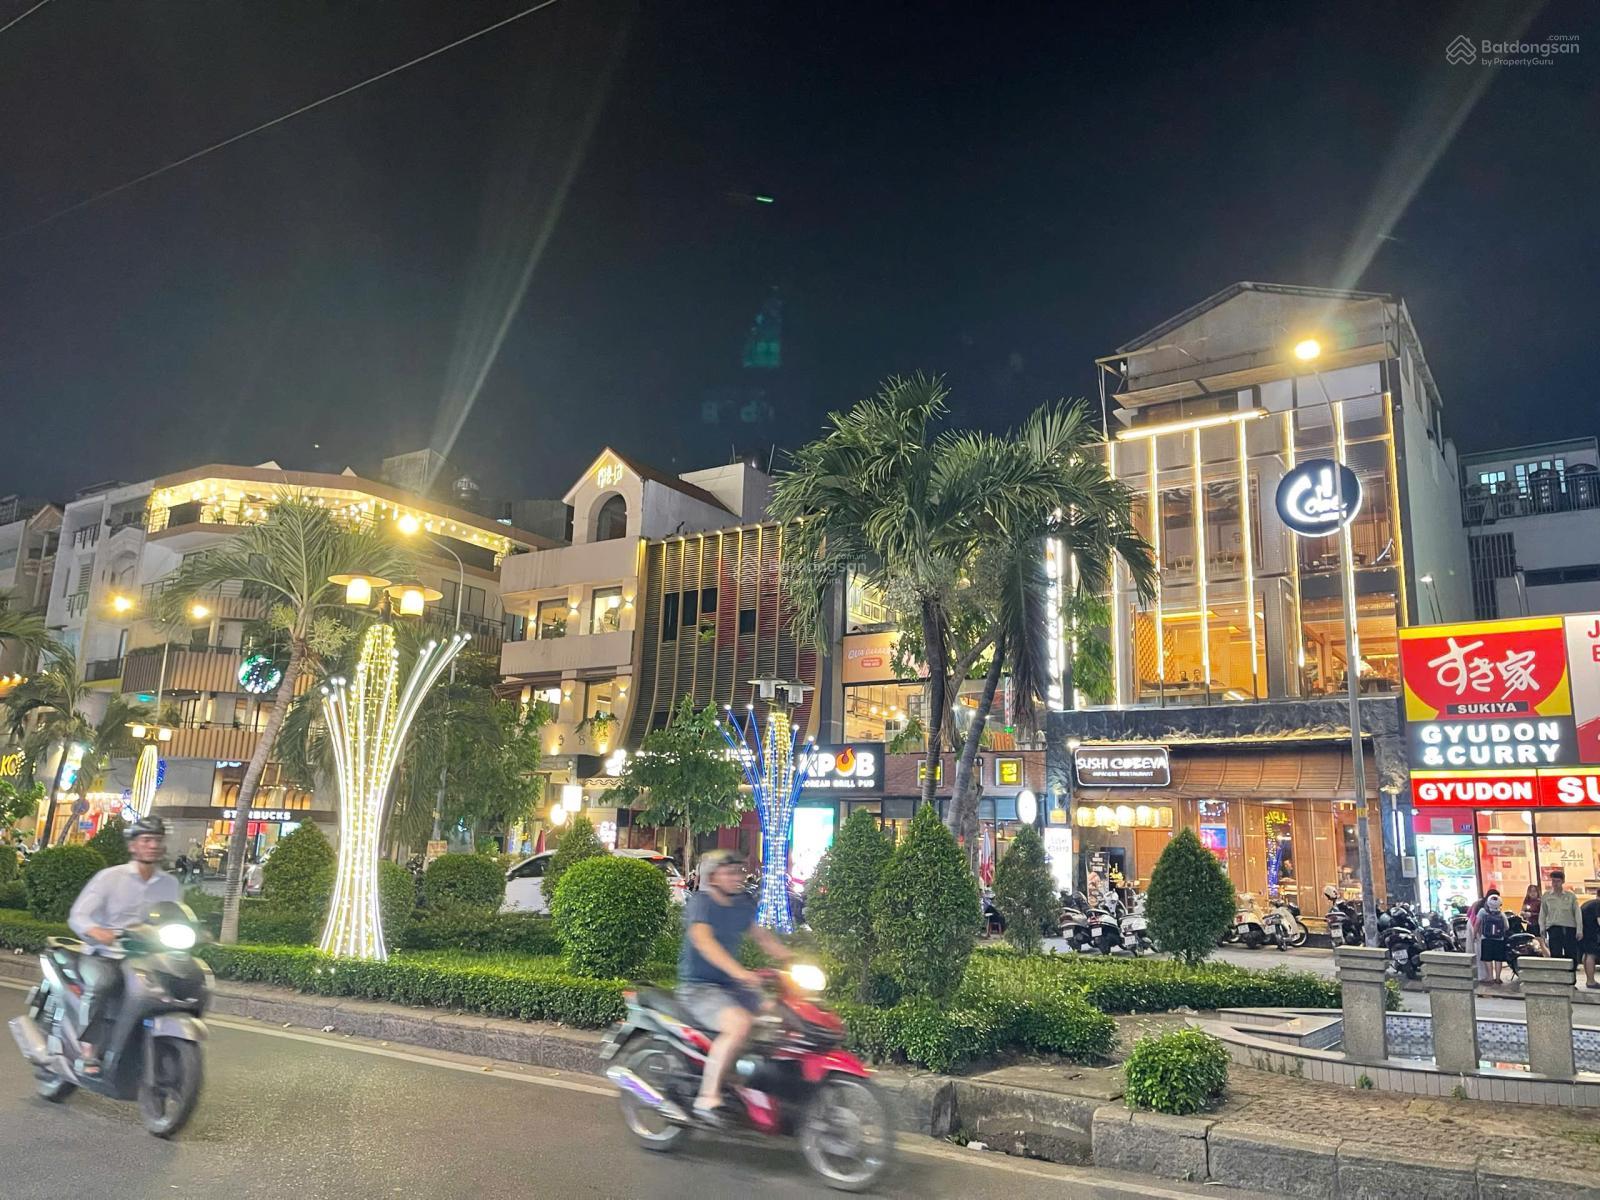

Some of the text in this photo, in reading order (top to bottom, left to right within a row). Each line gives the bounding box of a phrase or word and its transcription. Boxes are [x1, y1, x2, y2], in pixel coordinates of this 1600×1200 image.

[1427, 637, 1540, 700] すき家
[1457, 702, 1517, 714] SUKIYA
[1421, 722, 1560, 743] GYUDON
[1077, 757, 1109, 770] SUSHI
[1423, 744, 1560, 765] &CURRY
[1418, 782, 1533, 800] GYUDON
